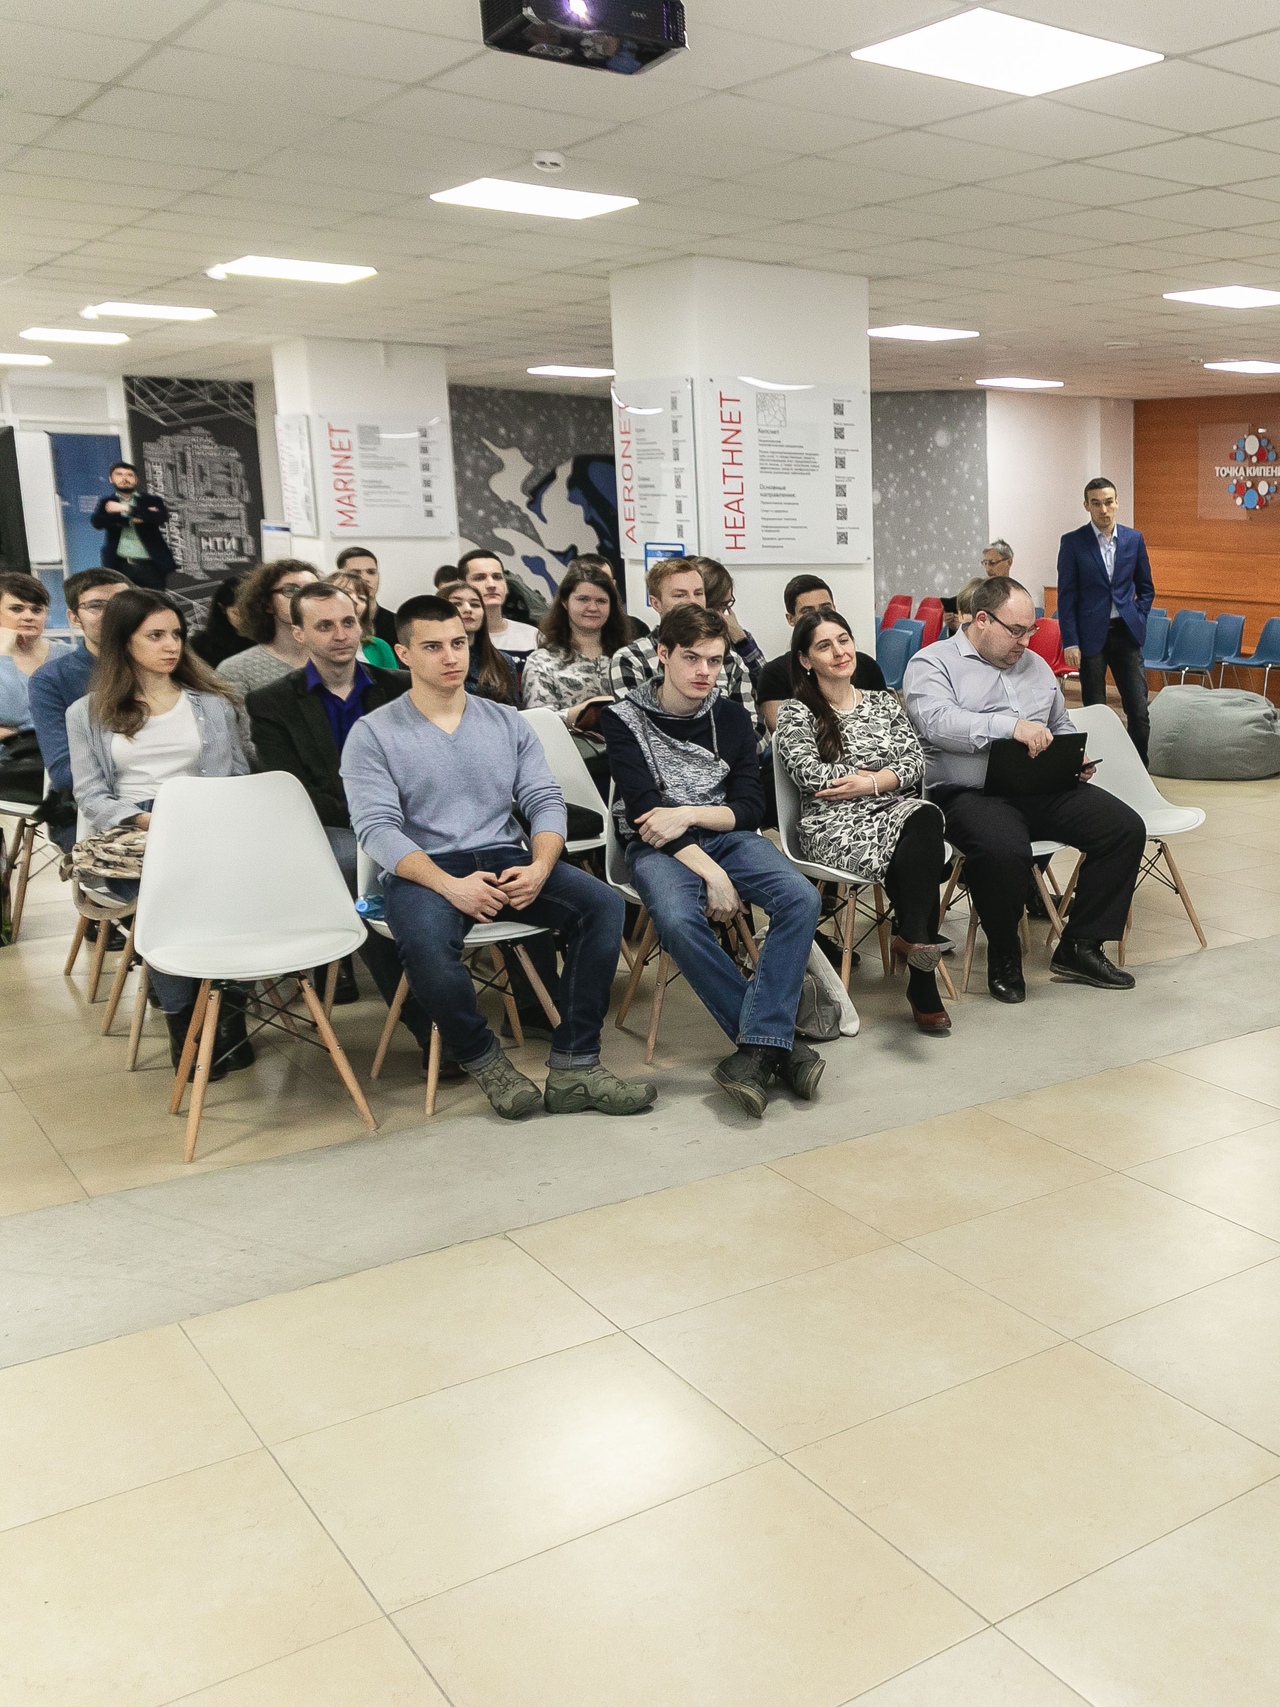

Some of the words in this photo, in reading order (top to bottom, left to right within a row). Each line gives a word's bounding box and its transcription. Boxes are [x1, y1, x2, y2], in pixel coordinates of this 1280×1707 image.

[327, 422, 359, 527] MARINET
[720, 390, 746, 550] HEALTHNET
[1215, 466, 1245, 477] ТОЧКА
[201, 537, 236, 551] НТИ
